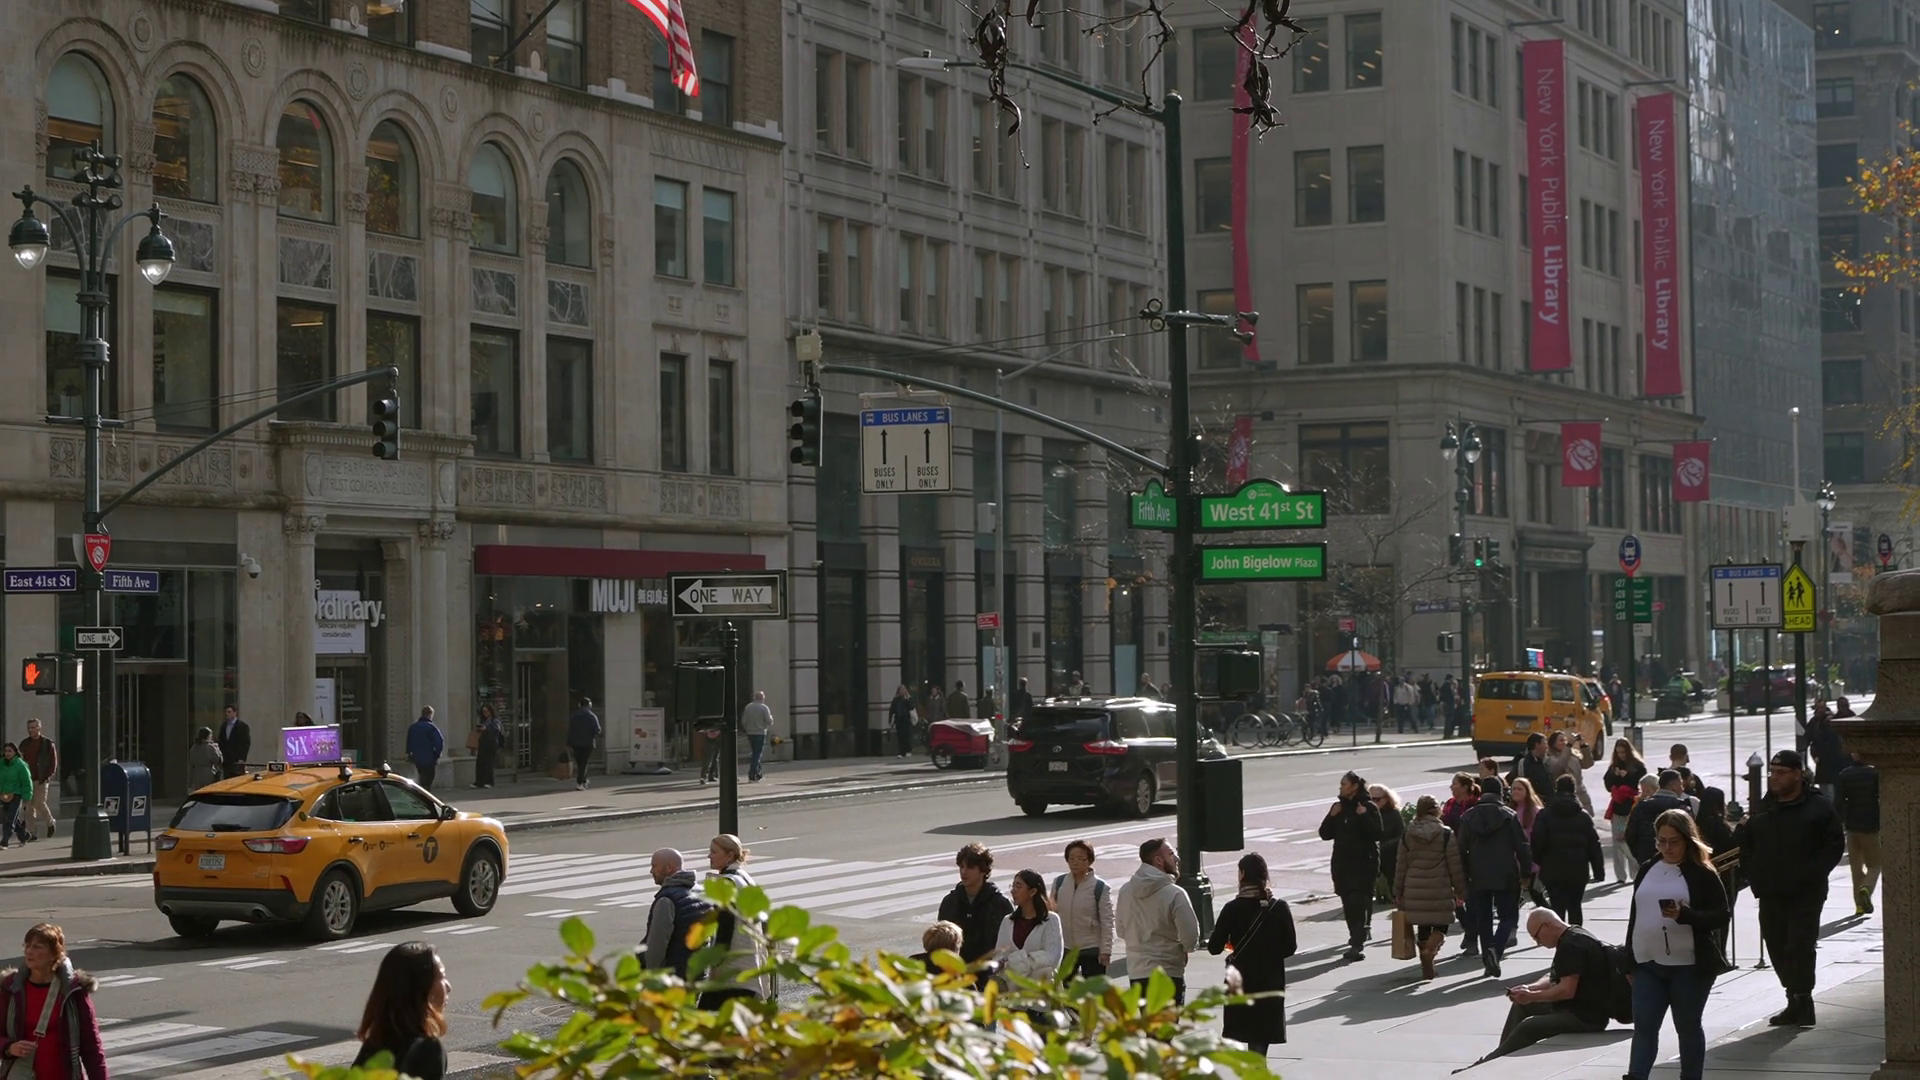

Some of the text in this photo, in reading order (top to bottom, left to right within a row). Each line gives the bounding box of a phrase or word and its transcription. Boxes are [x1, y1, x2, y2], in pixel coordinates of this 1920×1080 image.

[1536, 68, 1563, 324] New York Public Library
[1648, 118, 1671, 350] New York Public Library
[882, 411, 929, 423] BUS LANES
[325, 460, 341, 474] THE
[874, 467, 896, 477] BUSES
[917, 466, 939, 476] BUSES
[325, 477, 425, 496] TRUST COMPANY BUILDING
[875, 479, 894, 489] ONLY
[918, 478, 937, 488] ONLY
[1138, 502, 1171, 522] Fifth Ave
[1210, 501, 1314, 522] West 41st St
[1211, 555, 1318, 572] John Bigelow Plaza
[1728, 569, 1764, 577] BUS LANES
[10, 574, 71, 587] East 41st St
[112, 575, 150, 588] Fifth Ave
[592, 579, 635, 613] MUJI
[690, 588, 764, 603] ONE WAY
[315, 594, 386, 627] rdinary.
[82, 634, 115, 643] ONE WAY
